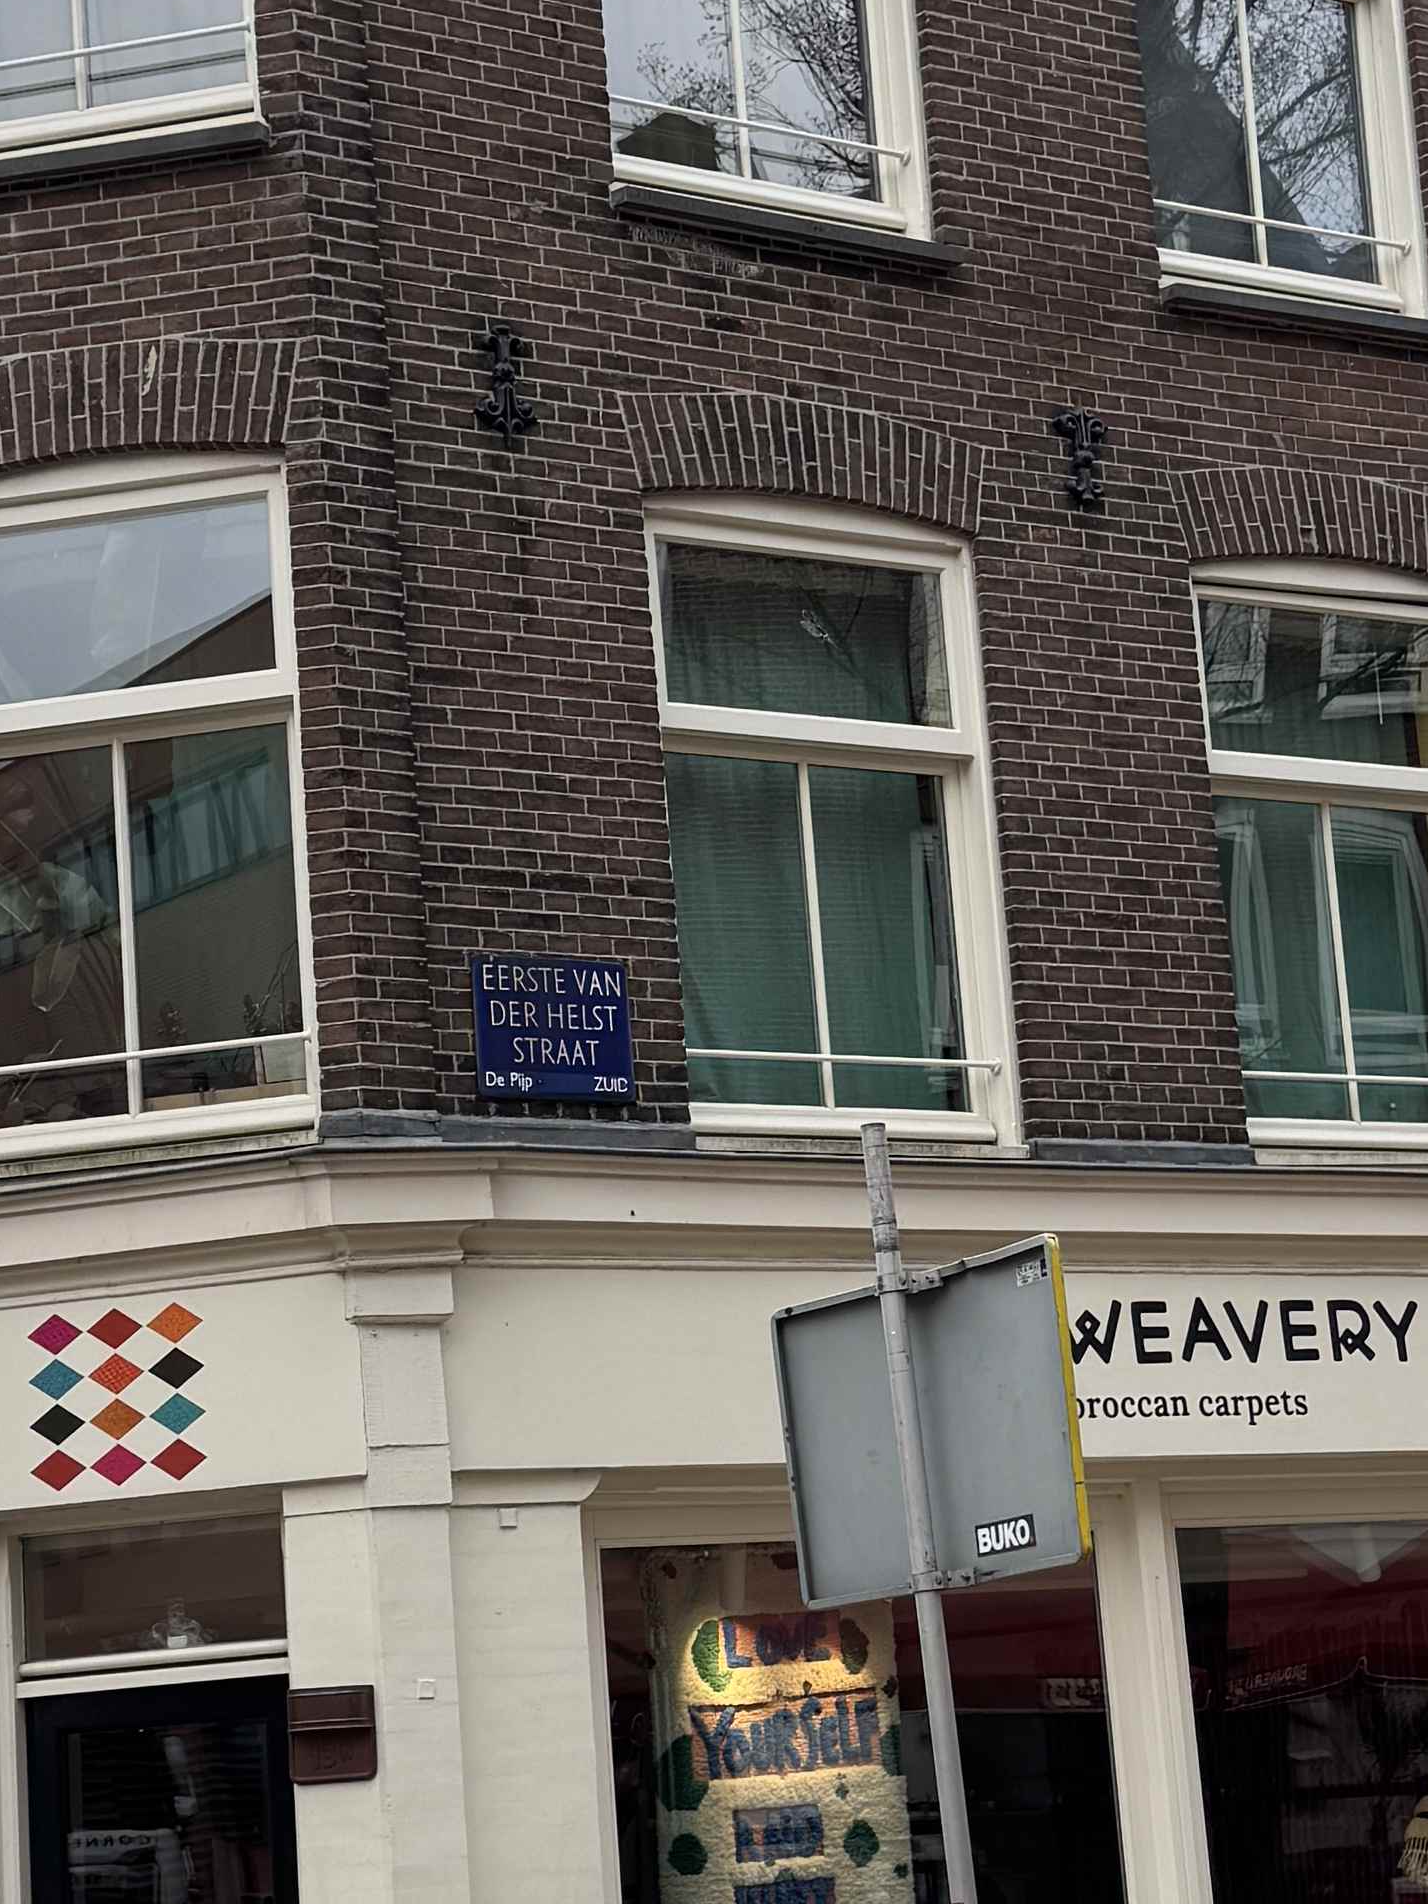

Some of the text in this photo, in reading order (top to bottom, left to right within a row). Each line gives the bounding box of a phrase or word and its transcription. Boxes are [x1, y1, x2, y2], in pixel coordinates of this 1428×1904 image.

[482, 964, 621, 997] EERSTE VAN
[490, 1000, 617, 1032] DER HELST
[513, 1037, 599, 1066] STRAAT
[485, 1071, 533, 1092] De Pijp
[593, 1076, 628, 1092] ZUID
[1070, 1297, 1418, 1364] WEAVERY
[1074, 1390, 1309, 1426] oroccan carpets
[977, 1519, 1030, 1554] BUKO
